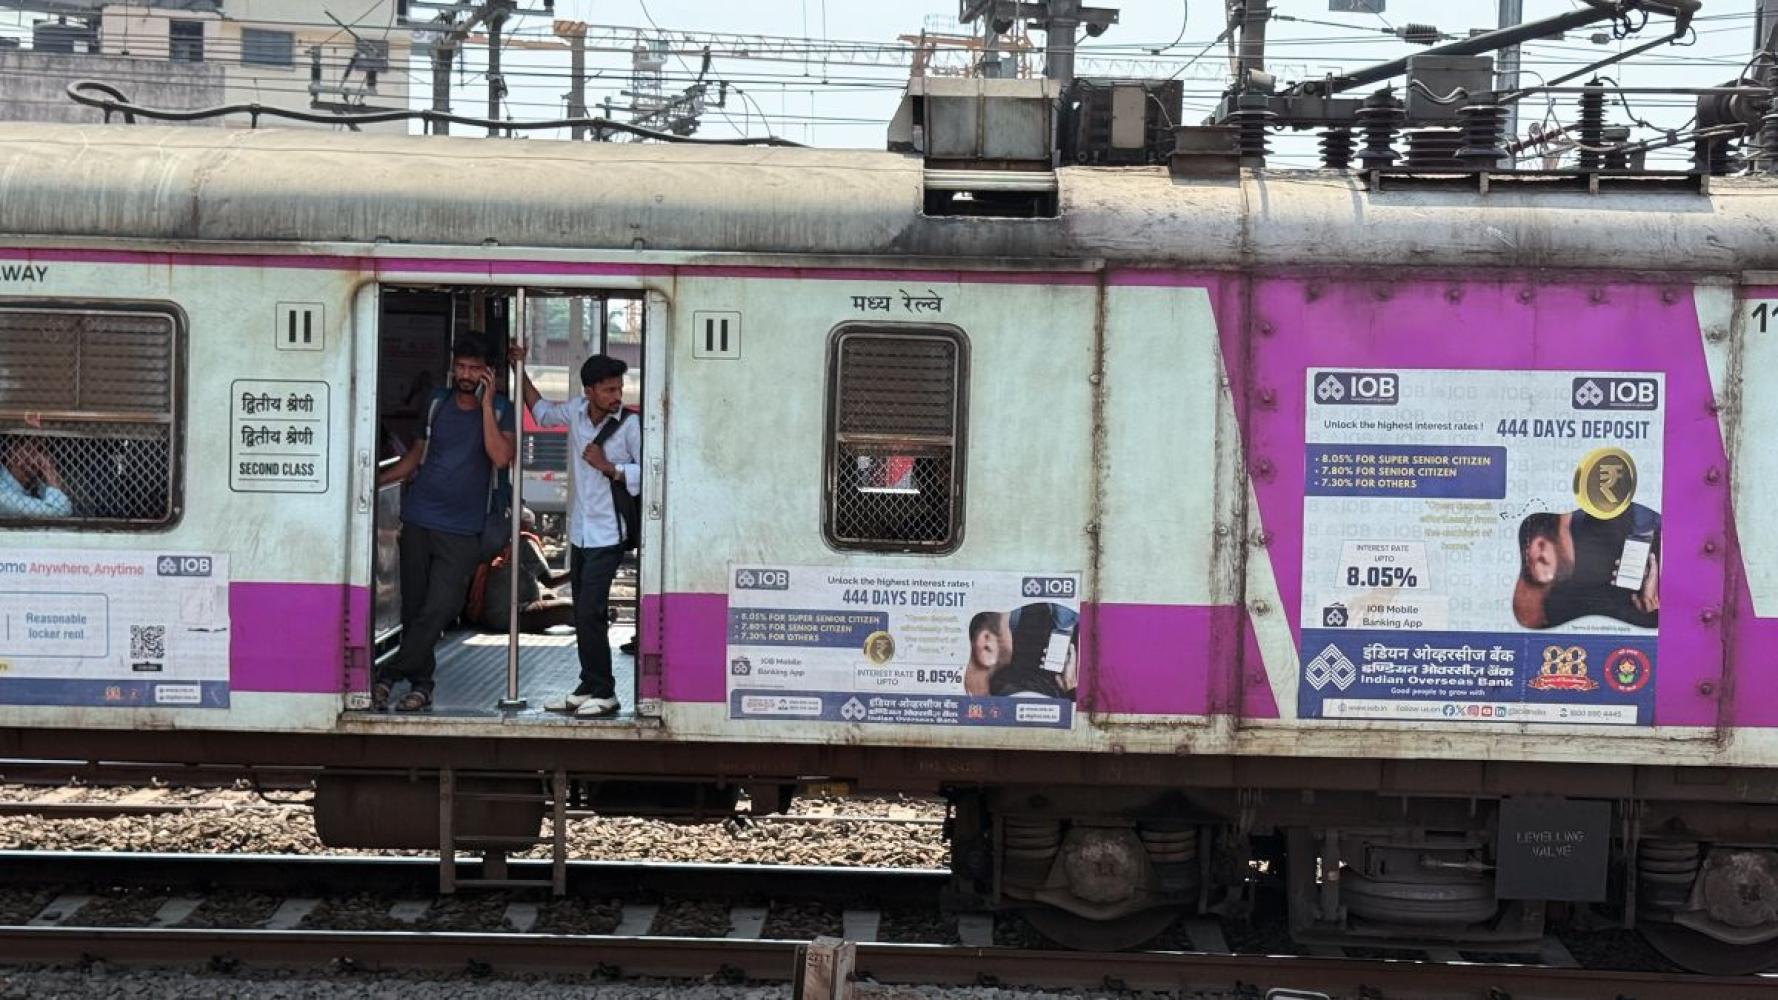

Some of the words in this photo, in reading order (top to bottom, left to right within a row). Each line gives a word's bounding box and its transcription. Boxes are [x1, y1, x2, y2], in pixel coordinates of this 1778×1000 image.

[0, 264, 48, 282] WAY
[850, 295, 892, 312] मध्य
[899, 288, 944, 313] रेल्वे
[1351, 376, 1395, 397] IOB
[1610, 381, 1655, 402] IOB
[242, 392, 281, 414] द्वितीय
[286, 392, 314, 412] श्रेणी
[1324, 420, 1357, 429] Unlock
[1360, 420, 1376, 430] the
[1377, 420, 1412, 431] highest
[1415, 421, 1452, 430] interest
[1454, 422, 1478, 431] rates
[1497, 419, 1529, 437] 444
[1533, 419, 1576, 438] DAYS
[1582, 420, 1650, 439] DEPOSIT
[241, 425, 281, 447] द्वितीय
[286, 425, 313, 445] श्रेणी
[1322, 455, 1353, 464] 8.05%
[1355, 455, 1375, 463] FOR
[1378, 455, 1409, 464] SUPER
[1412, 456, 1449, 465] SENIOR
[1452, 456, 1491, 465] CITIZEN
[239, 462, 279, 475] SECOND
[282, 463, 314, 476] CLASS
[1321, 466, 1353, 475] 7.80%
[1355, 467, 1375, 475] FOR
[1378, 467, 1415, 476] SENIOR
[1418, 468, 1457, 477] CITIZEN
[1321, 478, 1353, 487] 7.30%
[1355, 479, 1375, 487] FOR
[1378, 479, 1417, 488] OTHERS
[180, 558, 210, 572] IOB
[758, 572, 787, 586] IOB
[828, 577, 858, 585] Unlock
[877, 578, 910, 587] highest
[912, 579, 945, 587] interest
[947, 580, 970, 588] rates
[1347, 566, 1417, 588] 8.05%
[1045, 580, 1073, 593] IOB
[842, 589, 868, 604] 444
[872, 590, 907, 605] DAYS
[911, 591, 966, 607] DEPOSIT
[1367, 604, 1384, 613] IOB
[1387, 604, 1418, 614] Mobile
[26, 613, 87, 624] Reasonable
[769, 613, 785, 621] FOR
[816, 615, 845, 623] SENIOR
[848, 615, 880, 624] CITIZEN
[1363, 617, 1400, 628] Banking
[1403, 618, 1422, 628] App
[28, 628, 61, 640] locker
[63, 628, 84, 640] rent
[788, 624, 817, 632] SENIOR
[769, 633, 785, 641] FOR
[787, 633, 819, 642] OTHERS
[1362, 642, 1409, 660] इंडियन
[1413, 644, 1487, 662] ओव्हरसीज
[758, 668, 787, 677] Banking
[789, 669, 805, 677] App
[858, 669, 892, 677] INTEREST
[895, 670, 914, 678] RATE
[917, 669, 962, 683] 8.05%
[1361, 674, 1403, 684] Indian
[1408, 676, 1474, 686] Overseas
[1478, 677, 1513, 687] Bank
[1412, 688, 1437, 696] people
[1449, 689, 1467, 697] grow
